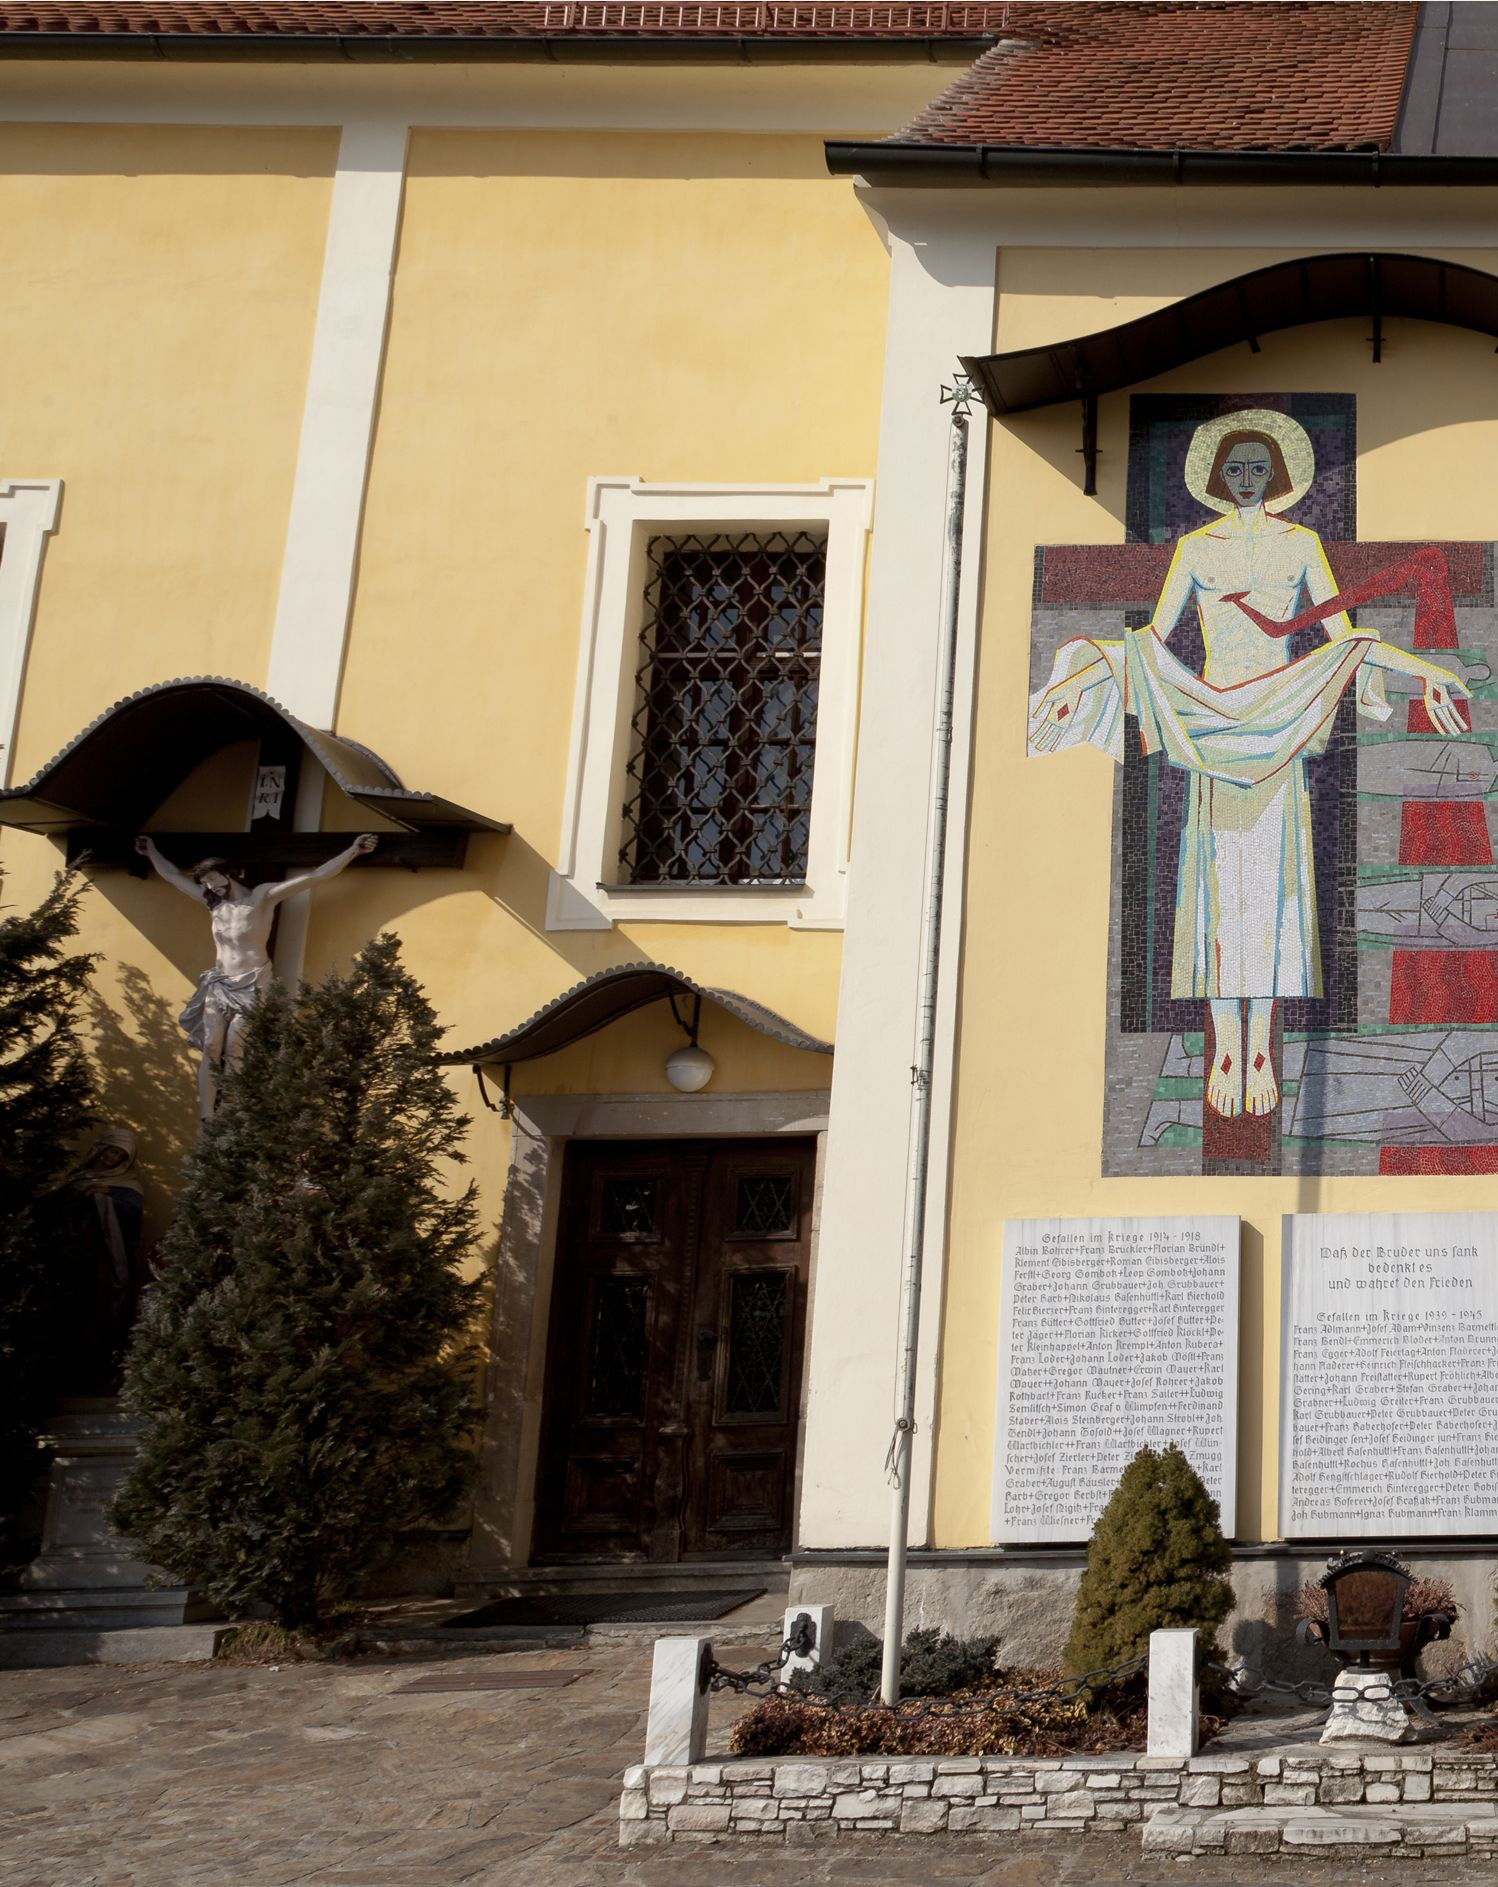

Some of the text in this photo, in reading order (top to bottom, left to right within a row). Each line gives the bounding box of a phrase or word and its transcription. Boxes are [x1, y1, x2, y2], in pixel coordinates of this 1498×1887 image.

[1041, 1230, 1201, 1243] Gefallen im Kriege 1914 1918
[1352, 1246, 1370, 1258] der
[1376, 1246, 1420, 1257] Bruder
[1424, 1245, 1447, 1256] uns
[1368, 1261, 1432, 1273] bedenkt es
[1328, 1277, 1350, 1289] und
[1403, 1276, 1425, 1288] den
[1429, 1275, 1473, 1288] Frieden
[1316, 1311, 1359, 1322] Gefallen
[1365, 1311, 1377, 1320] im
[1383, 1309, 1419, 1321] Kriege
[1424, 1310, 1447, 1319] 1939
[1062, 1464, 1087, 1475] Franz
